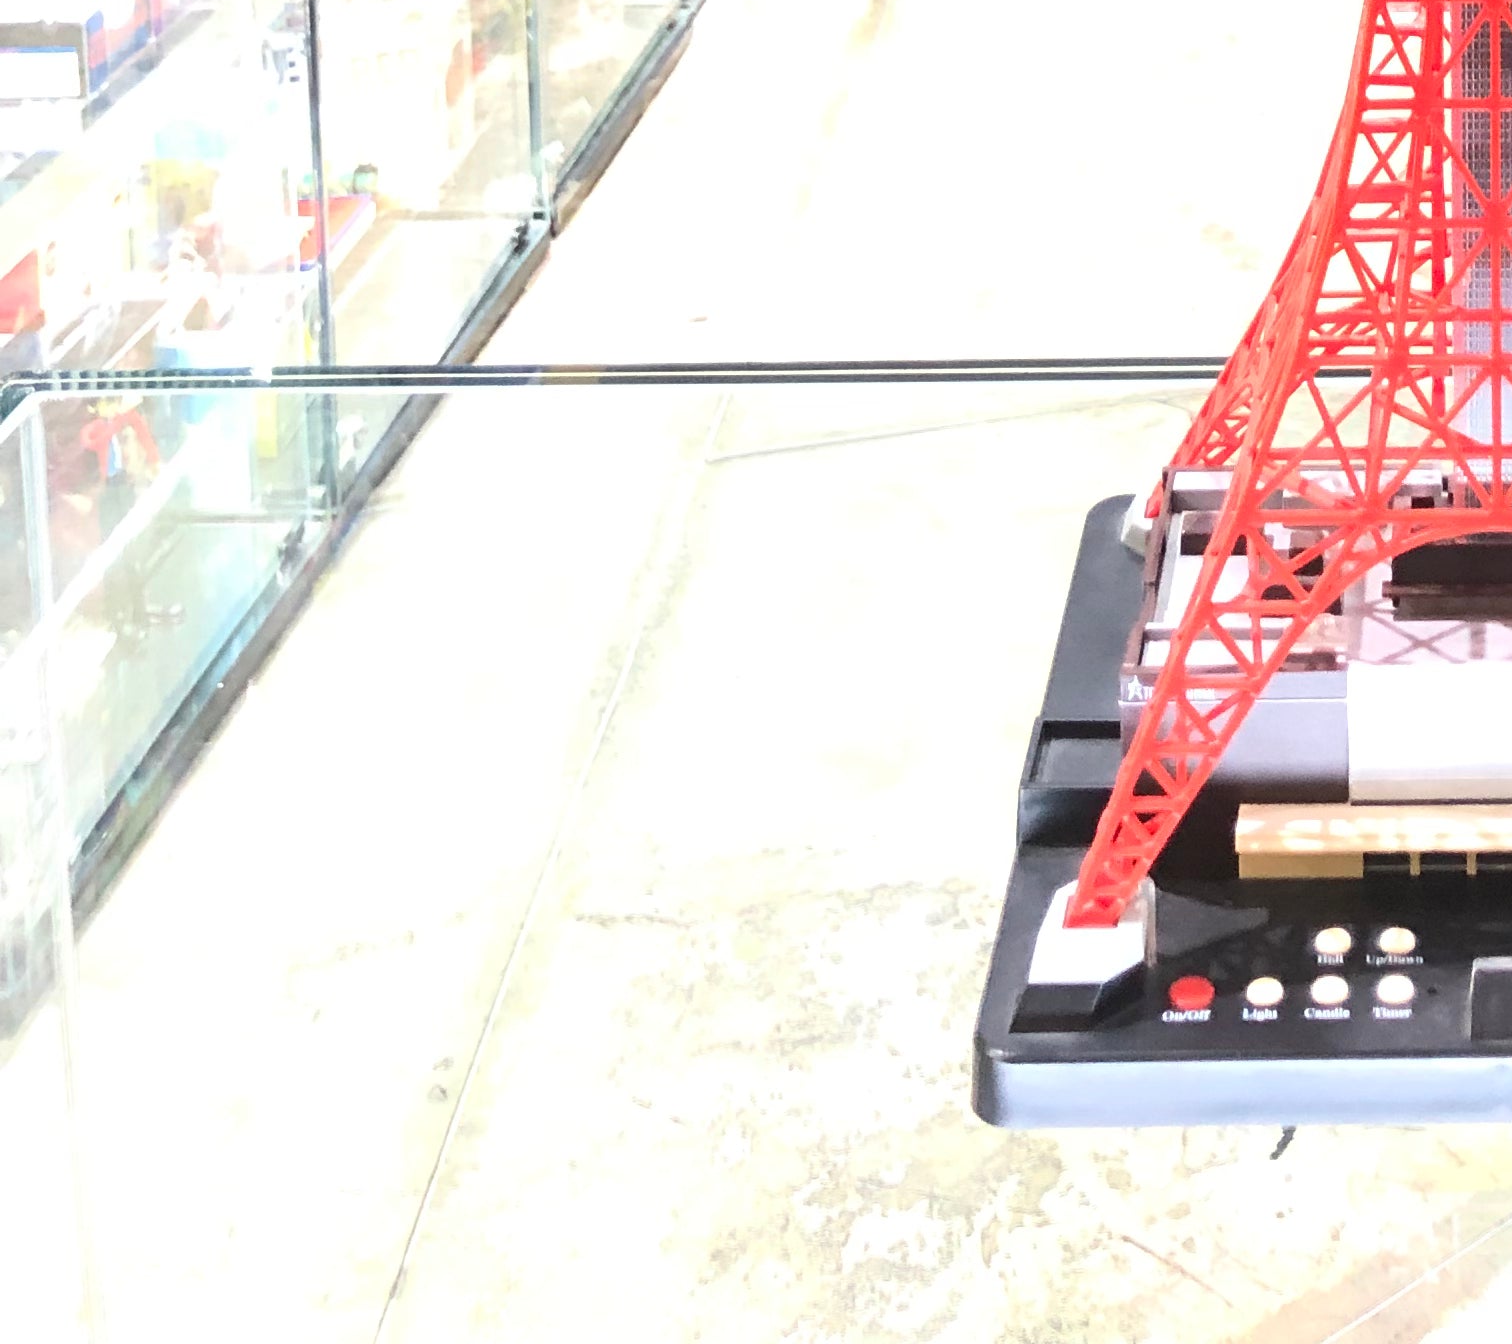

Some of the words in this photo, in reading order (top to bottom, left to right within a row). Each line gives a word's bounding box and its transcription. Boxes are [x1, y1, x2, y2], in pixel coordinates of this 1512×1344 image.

[1161, 1008, 1212, 1023] On/Off
[1242, 1007, 1279, 1022] Light
[1303, 1006, 1351, 1021] Candle
